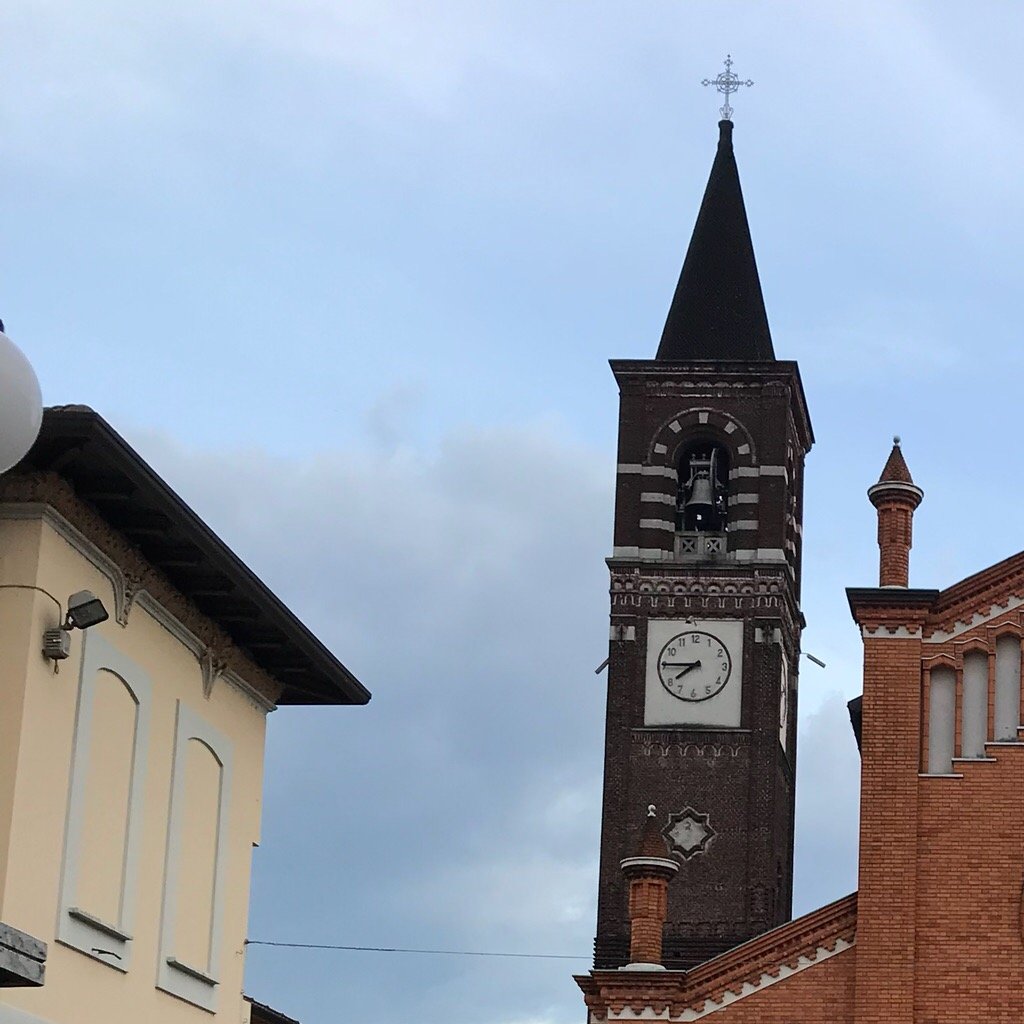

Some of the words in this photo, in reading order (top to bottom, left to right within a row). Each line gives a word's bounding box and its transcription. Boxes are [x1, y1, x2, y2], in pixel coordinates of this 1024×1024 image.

[678, 638, 685, 647] 11
[691, 634, 700, 643] 12
[707, 638, 711, 647] 1
[667, 647, 676, 656] 10
[717, 648, 723, 657] 2
[722, 662, 728, 671] 3
[667, 678, 673, 686] 8
[715, 676, 721, 684] 4
[677, 685, 683, 694] 7
[691, 688, 696, 698] 6
[705, 686, 711, 694] 5
